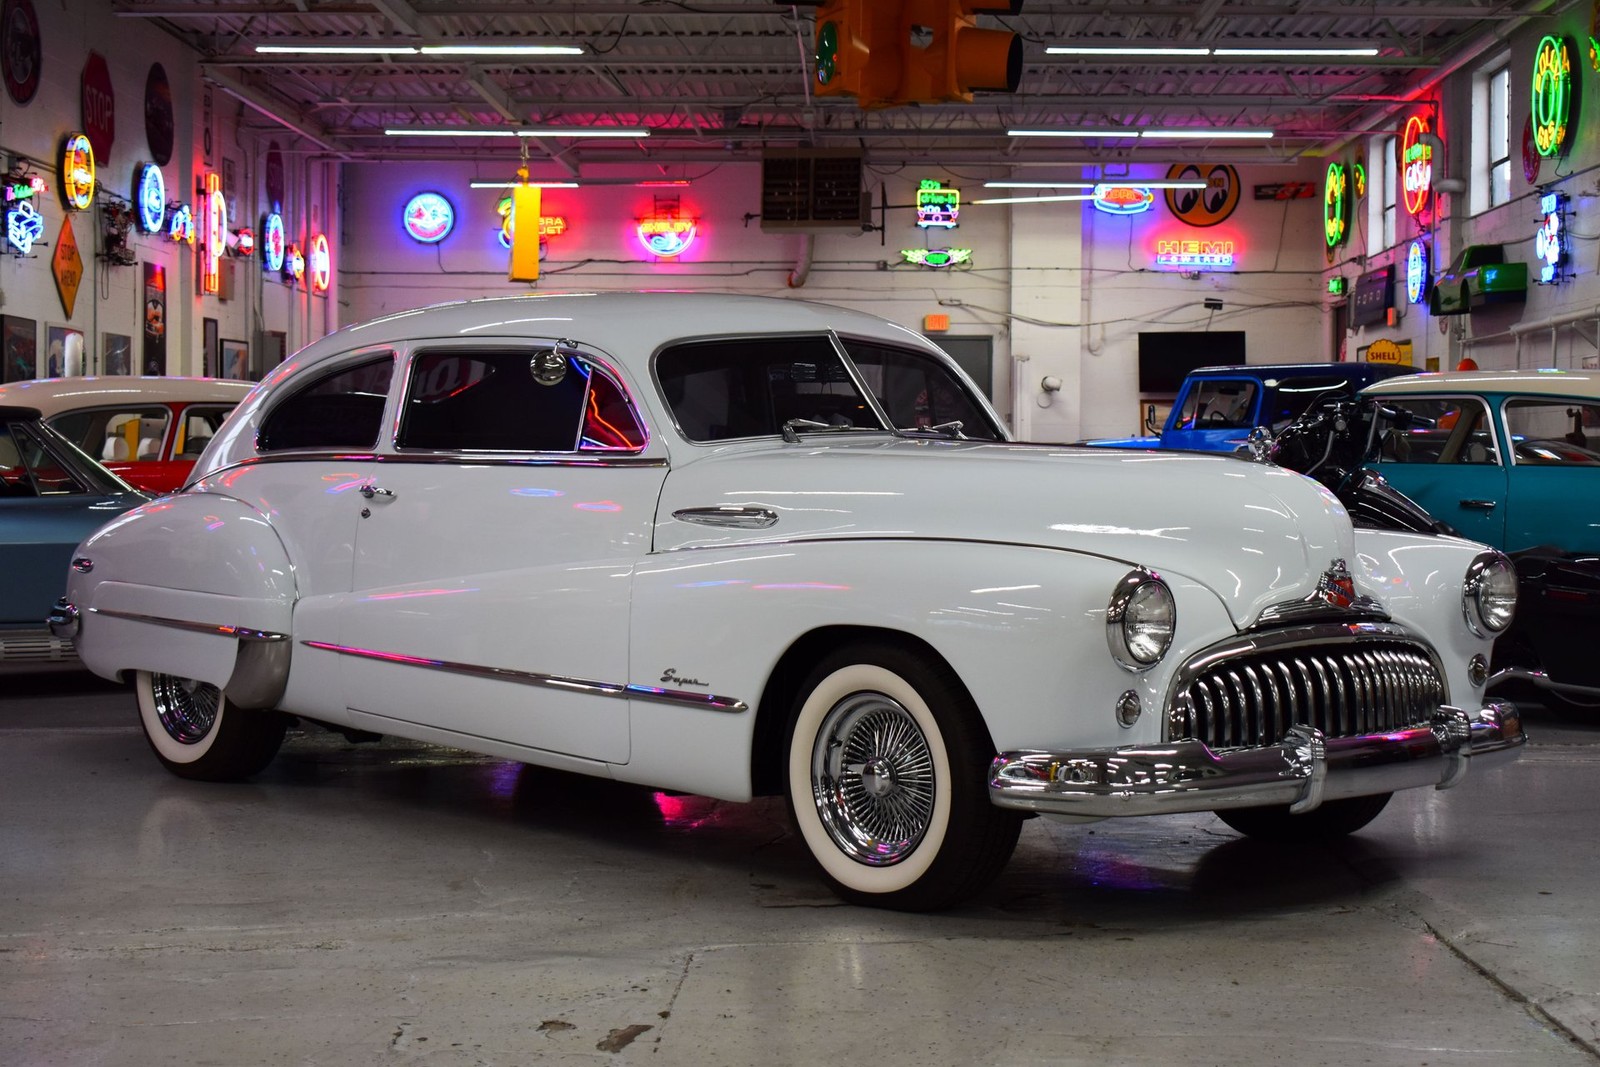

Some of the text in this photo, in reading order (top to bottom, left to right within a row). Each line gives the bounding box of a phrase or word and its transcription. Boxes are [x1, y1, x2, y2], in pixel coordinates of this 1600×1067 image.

[86, 84, 112, 133] STOP
[539, 216, 564, 226] BRA
[61, 244, 75, 261] STOP
[1158, 241, 1233, 255] HEMI
[1370, 351, 1397, 361] SHELL
[660, 668, 709, 687] Super
